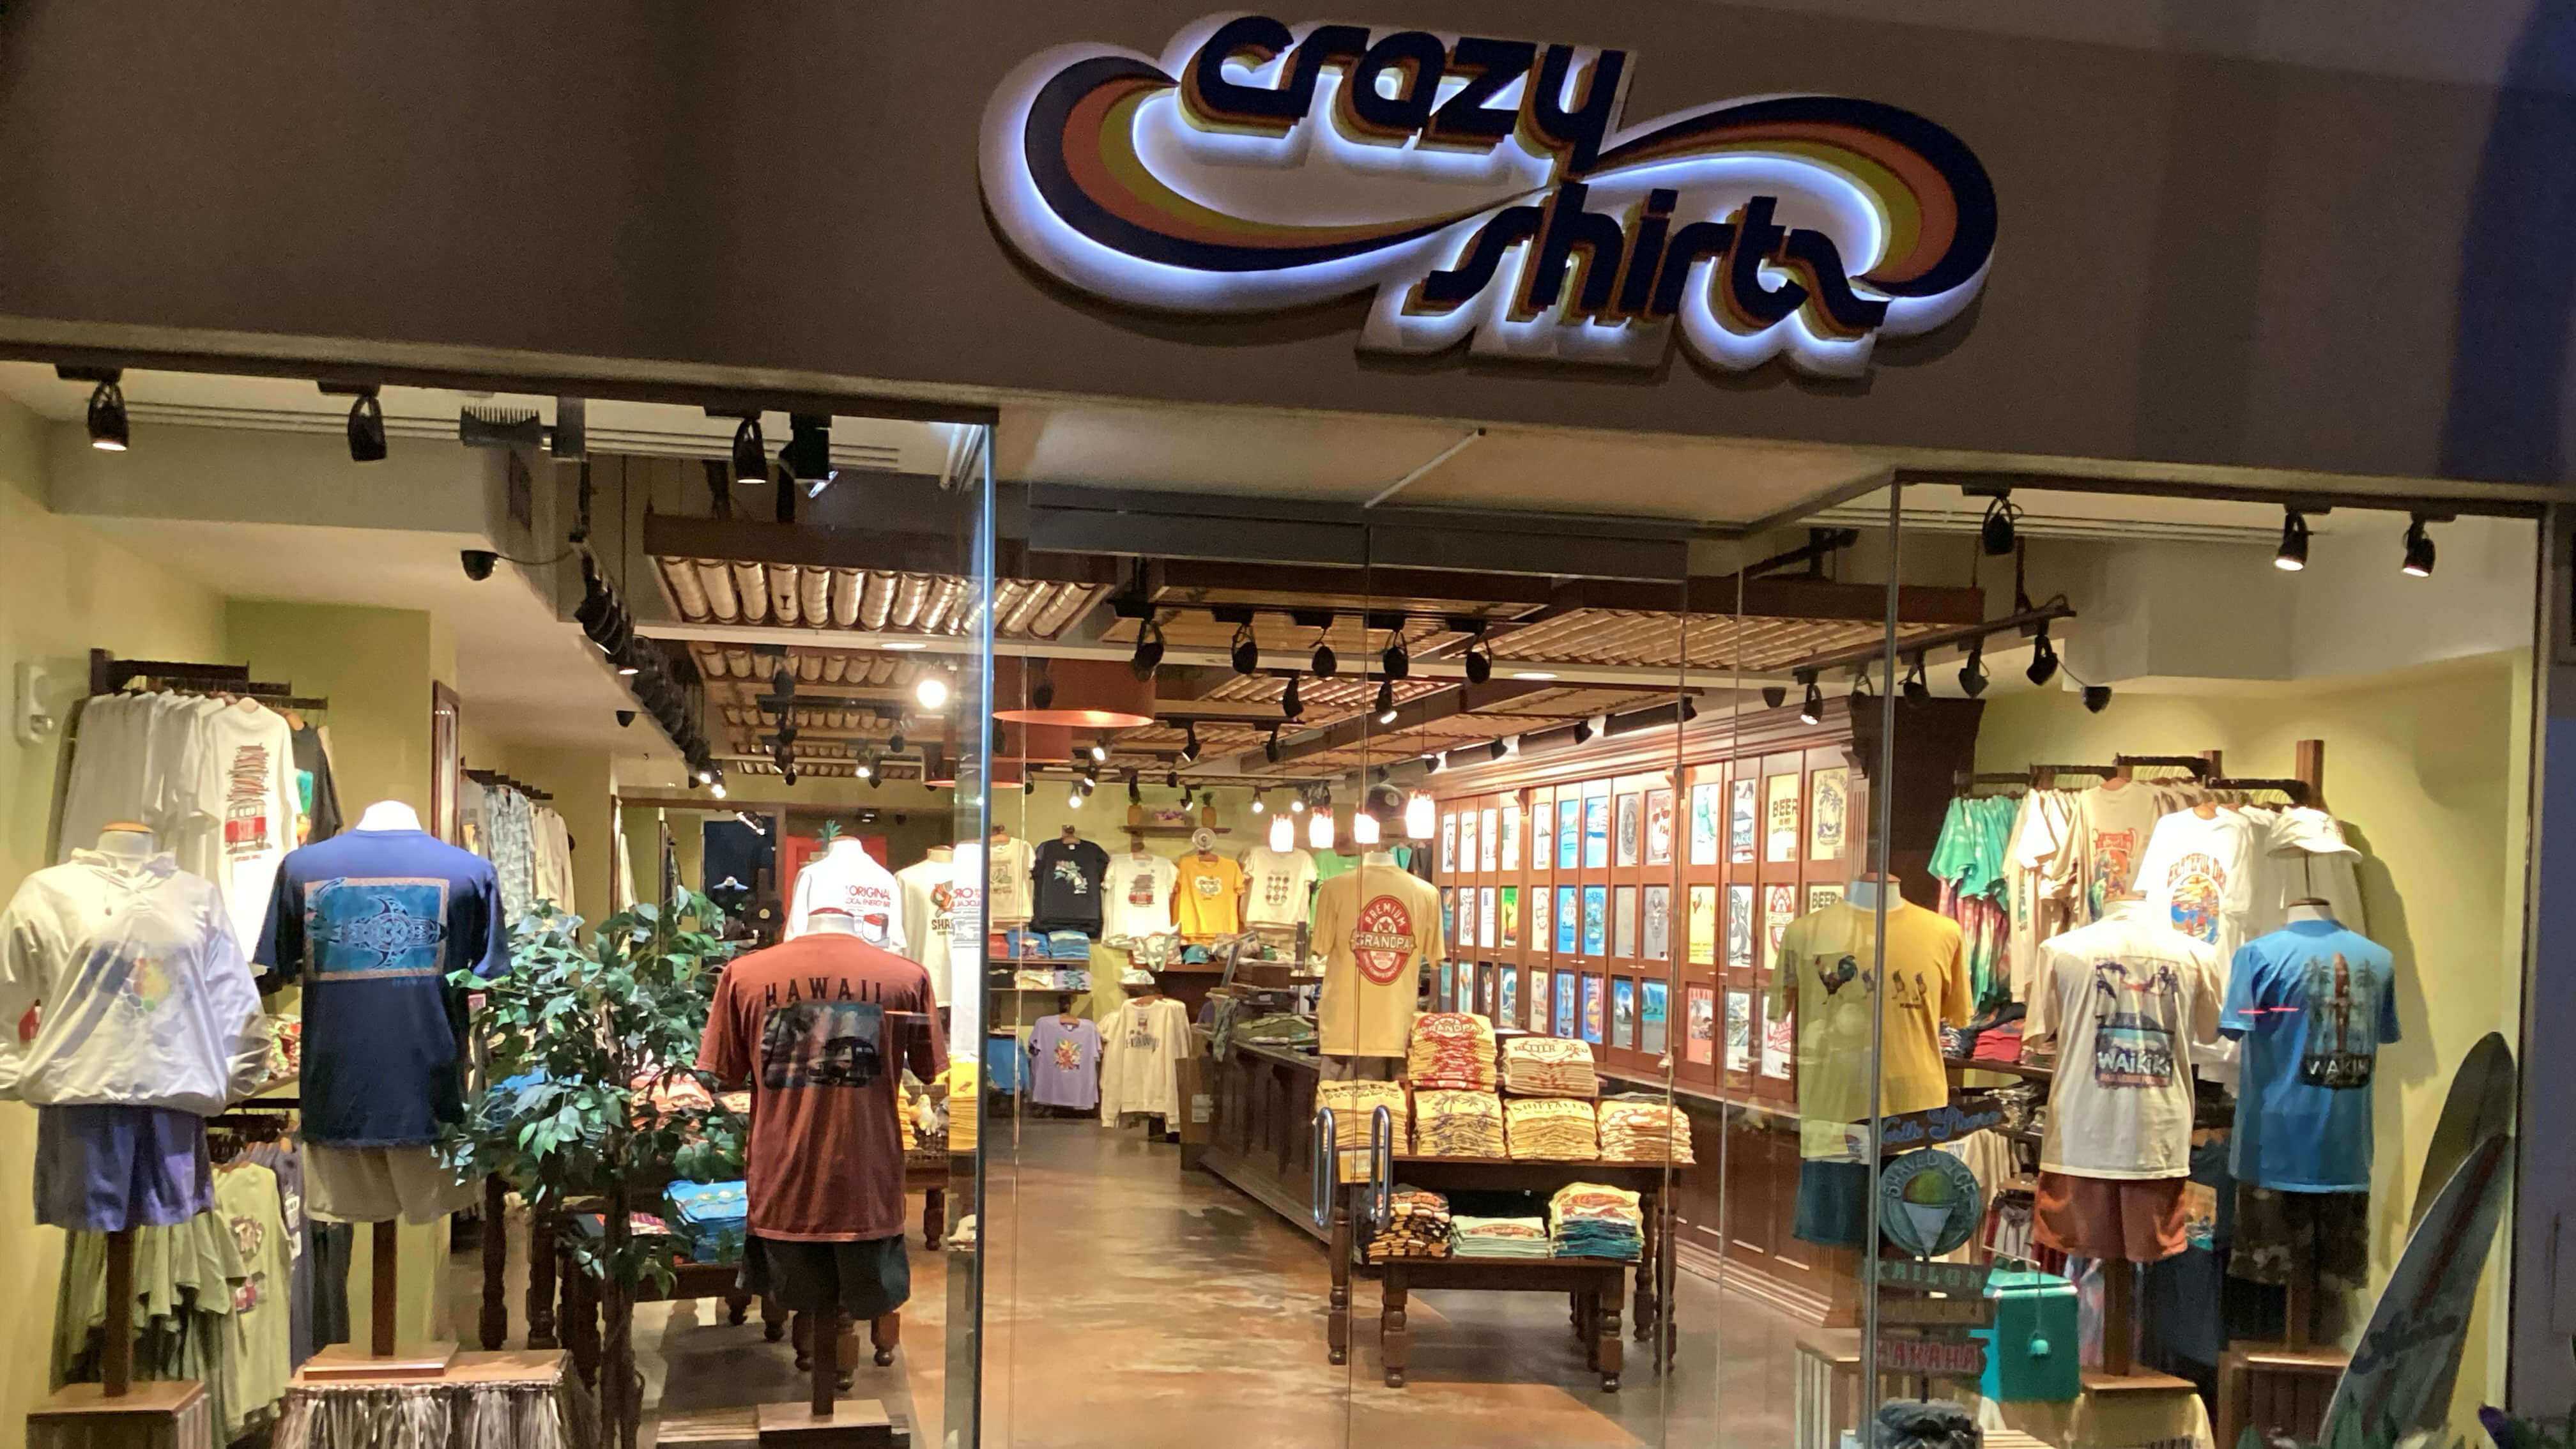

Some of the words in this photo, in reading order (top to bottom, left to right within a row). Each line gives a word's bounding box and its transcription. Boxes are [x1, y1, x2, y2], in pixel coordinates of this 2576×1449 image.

[1185, 14, 1628, 176] crazy
[1409, 181, 1891, 331] shirts
[1772, 799, 1799, 818] BEER
[1364, 902, 1406, 926] PREMIUM
[1357, 933, 1410, 949] GRANDPA
[765, 976, 881, 1007] HAWAII
[1885, 1151, 1939, 1197] SHAVED
[1943, 1160, 1977, 1194] ICE
